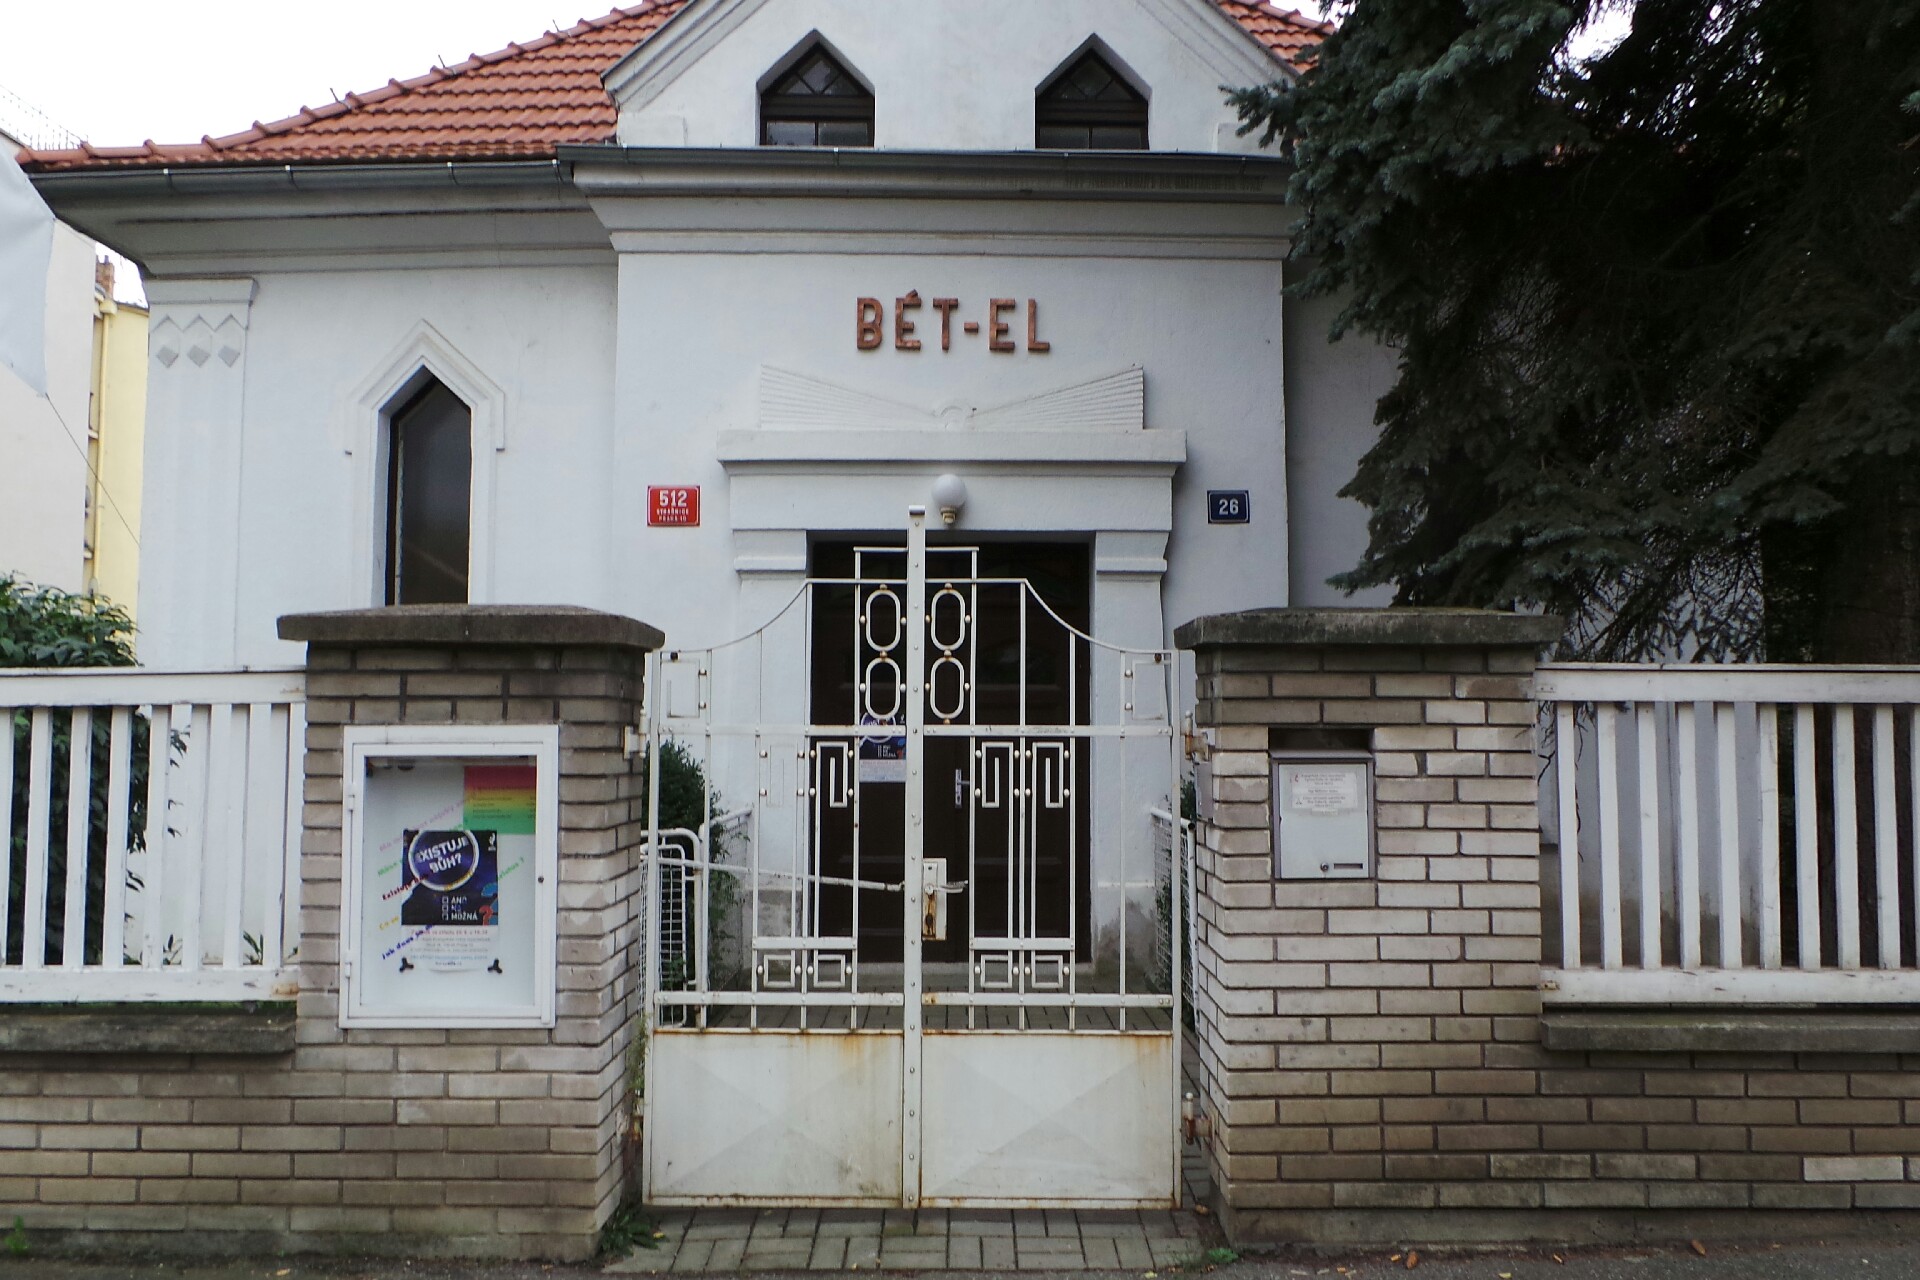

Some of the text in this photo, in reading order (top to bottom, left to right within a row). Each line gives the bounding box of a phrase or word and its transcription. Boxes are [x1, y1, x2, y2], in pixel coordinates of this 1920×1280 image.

[856, 289, 1050, 352] BÉT-EL
[659, 489, 687, 507] 512
[1219, 498, 1239, 515] 26
